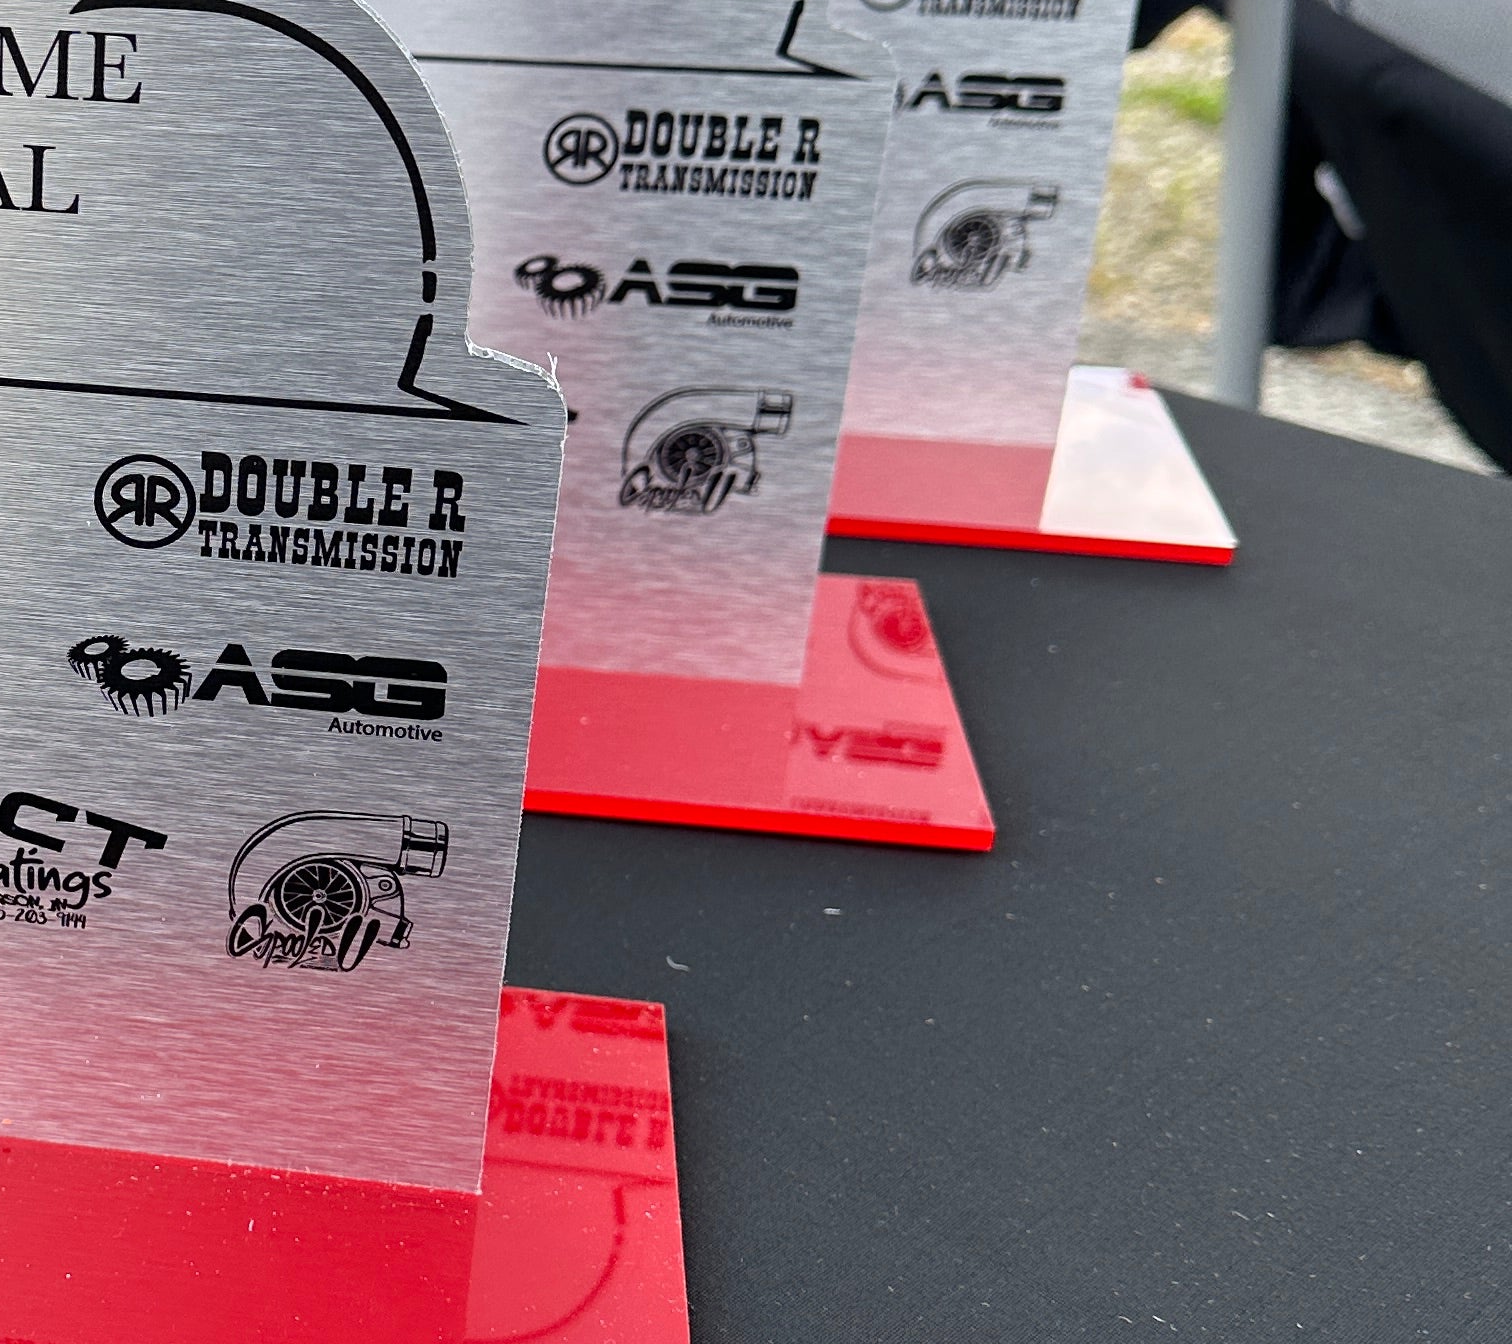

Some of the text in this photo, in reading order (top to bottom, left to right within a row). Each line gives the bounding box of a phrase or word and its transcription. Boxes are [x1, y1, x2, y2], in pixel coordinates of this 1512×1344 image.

[907, 72, 1066, 112] ASG
[624, 109, 820, 164] DOUBLE R
[619, 163, 817, 200] TRANSMISSION
[608, 257, 799, 311] ASG
[707, 312, 793, 329] Automotive
[199, 451, 466, 533] DOUBLE R
[198, 520, 463, 578] TRANSMISSION
[191, 643, 448, 721] ASG
[328, 717, 443, 742] Automotive
